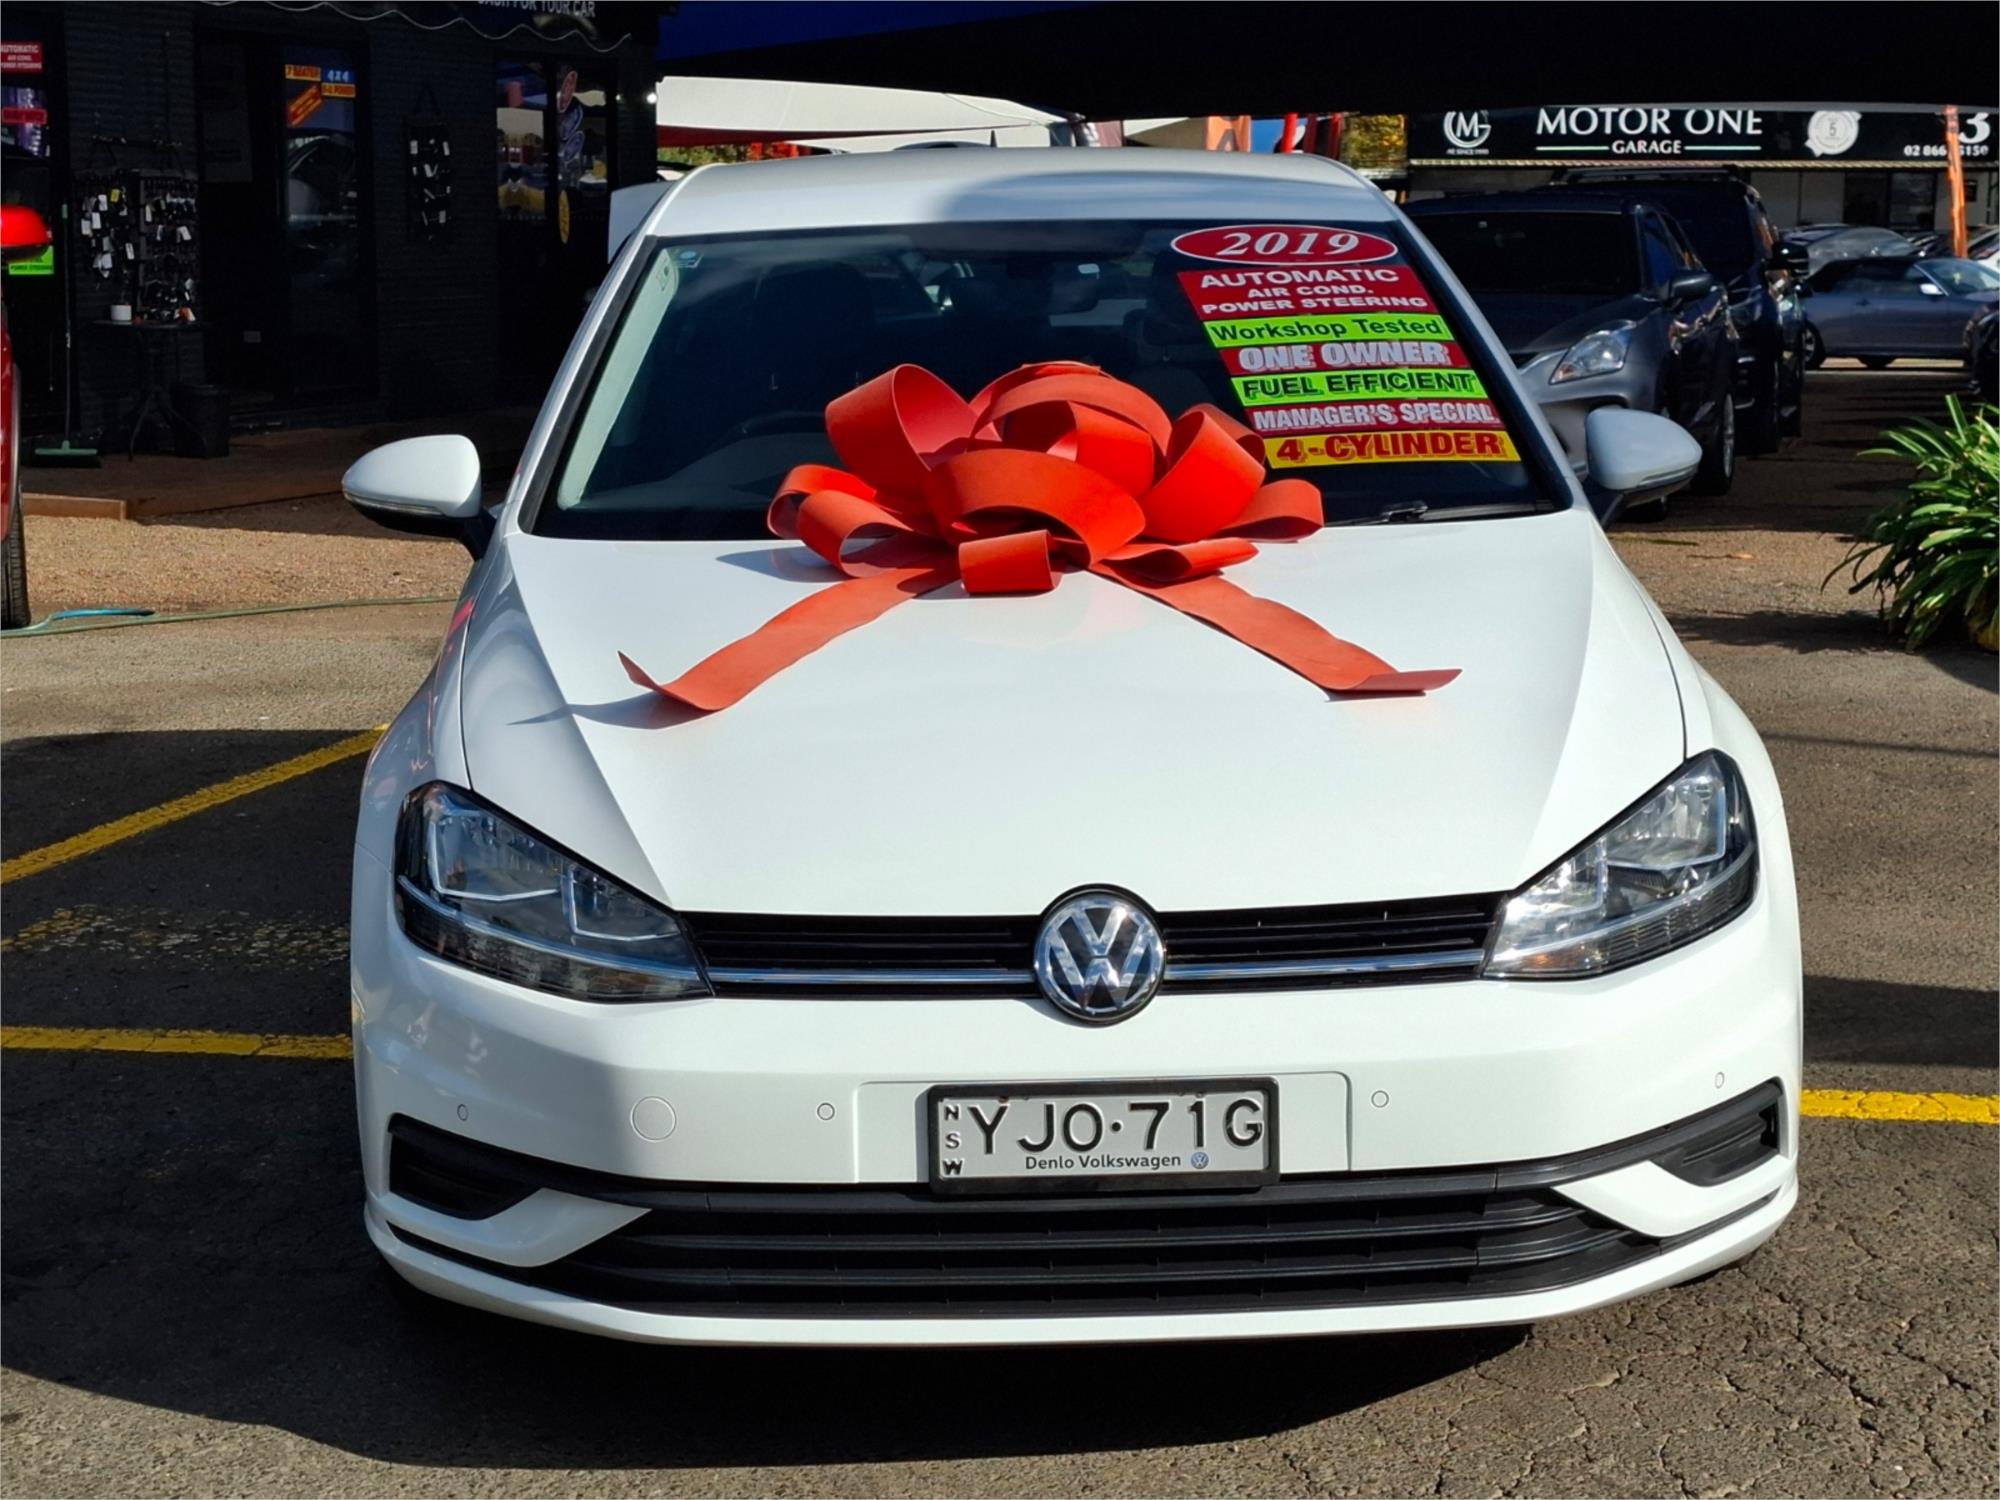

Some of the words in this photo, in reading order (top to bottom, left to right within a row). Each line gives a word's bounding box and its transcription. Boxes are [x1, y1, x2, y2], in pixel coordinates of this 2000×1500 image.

[573, 0, 596, 18] CAR
[1536, 106, 1671, 135] MOTOR
[1684, 108, 1763, 135] ONE
[1612, 139, 1683, 155] GARAGE
[1216, 231, 1360, 256] 2019
[1201, 268, 1400, 289] AUTOMATIC
[1248, 287, 1291, 299] AIR
[1296, 283, 1374, 296] COND.
[1202, 299, 1295, 315] POWER
[1300, 296, 1428, 309] STEERING
[1210, 319, 1347, 342] Workshop
[1355, 316, 1442, 335] Tested
[1238, 347, 1316, 372] ONE
[1321, 341, 1451, 367] OWNER
[1242, 376, 1324, 400] FUEL
[1326, 370, 1477, 394] EFFICIENT
[1025, 1155, 1075, 1170] Denlo
[1078, 1153, 1182, 1171] Volkswagen
